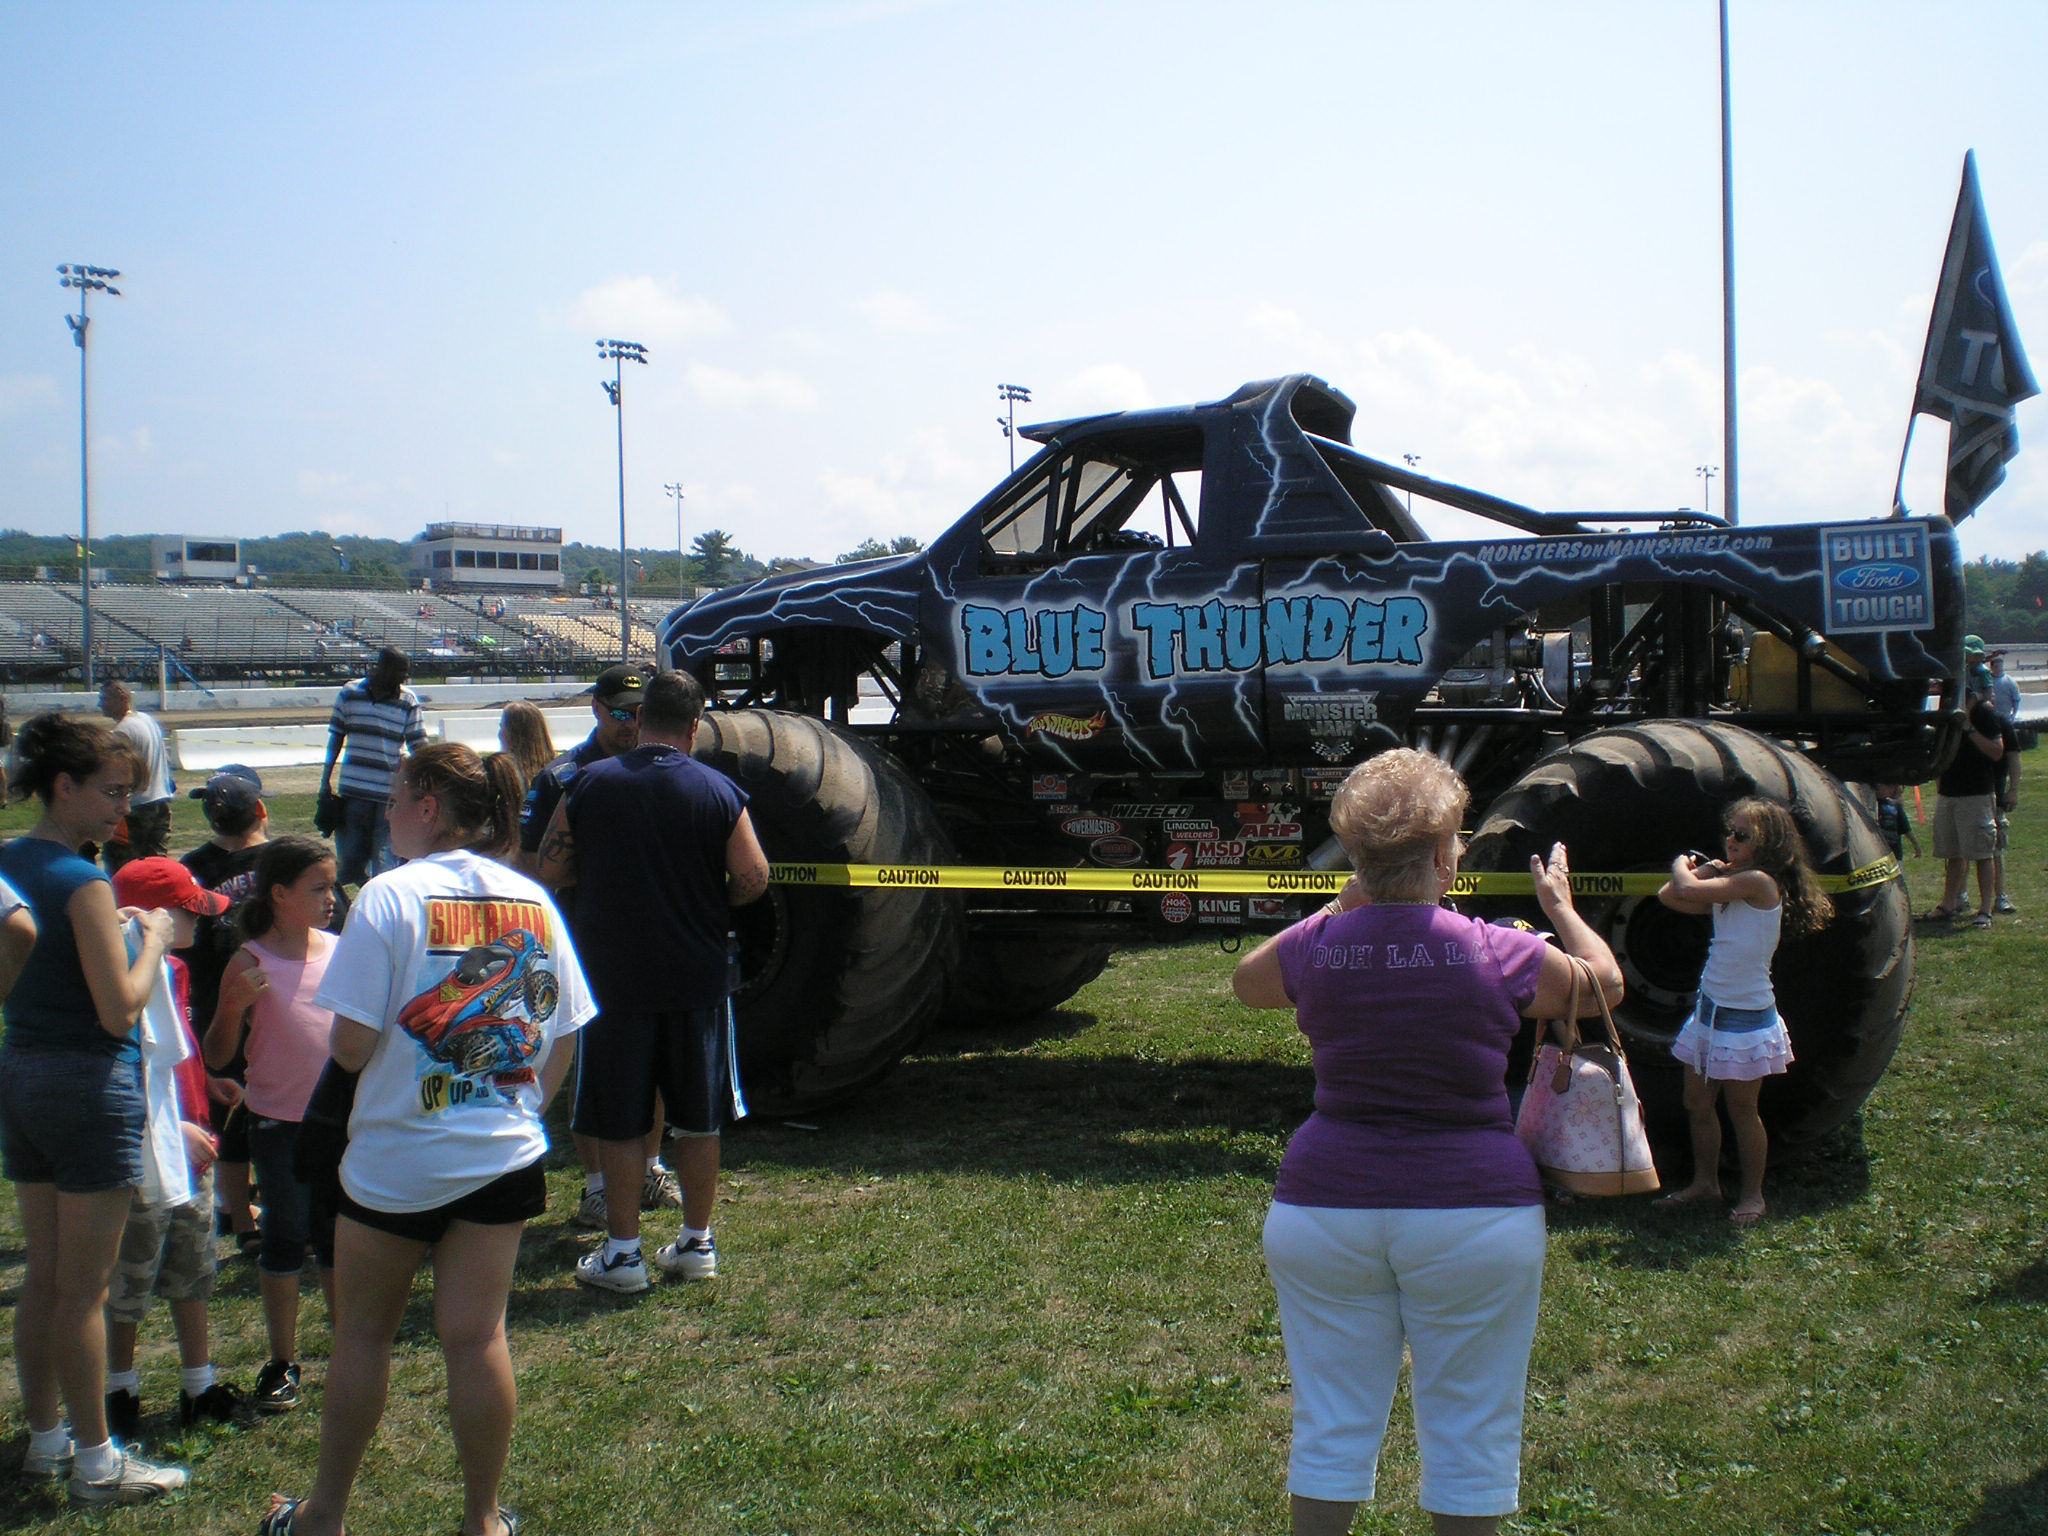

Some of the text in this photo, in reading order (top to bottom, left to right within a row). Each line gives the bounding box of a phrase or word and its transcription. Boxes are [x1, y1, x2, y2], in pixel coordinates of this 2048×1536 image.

[1833, 532, 1918, 561] BUILT
[1853, 568, 1903, 587] Ford
[1837, 595, 1922, 622] TOUGH
[961, 594, 1428, 679] BLUE THUNDER
[1284, 703, 1377, 720] MONSTER
[1311, 720, 1352, 736] JAM
[1110, 804, 1194, 818] WISECO
[1067, 819, 1115, 834] POWERMASTER
[1167, 822, 1209, 830] LINCOLN
[1238, 824, 1302, 838] ARP
[1199, 841, 1245, 857] MSD
[769, 867, 816, 881] AUTION
[878, 869, 939, 884] CAUTION
[1003, 871, 1067, 886] CAUTION
[1133, 873, 1199, 889] CAUTION
[1267, 874, 1336, 890] CAUTION
[1573, 877, 1623, 892] UTION
[1167, 899, 1186, 907] NGK
[1199, 900, 1240, 912] KING
[431, 902, 545, 947] SUPERMAN
[1313, 941, 1489, 970] OOH LA LA
[421, 1073, 443, 1110] UP
[449, 1079, 472, 1106] UP
